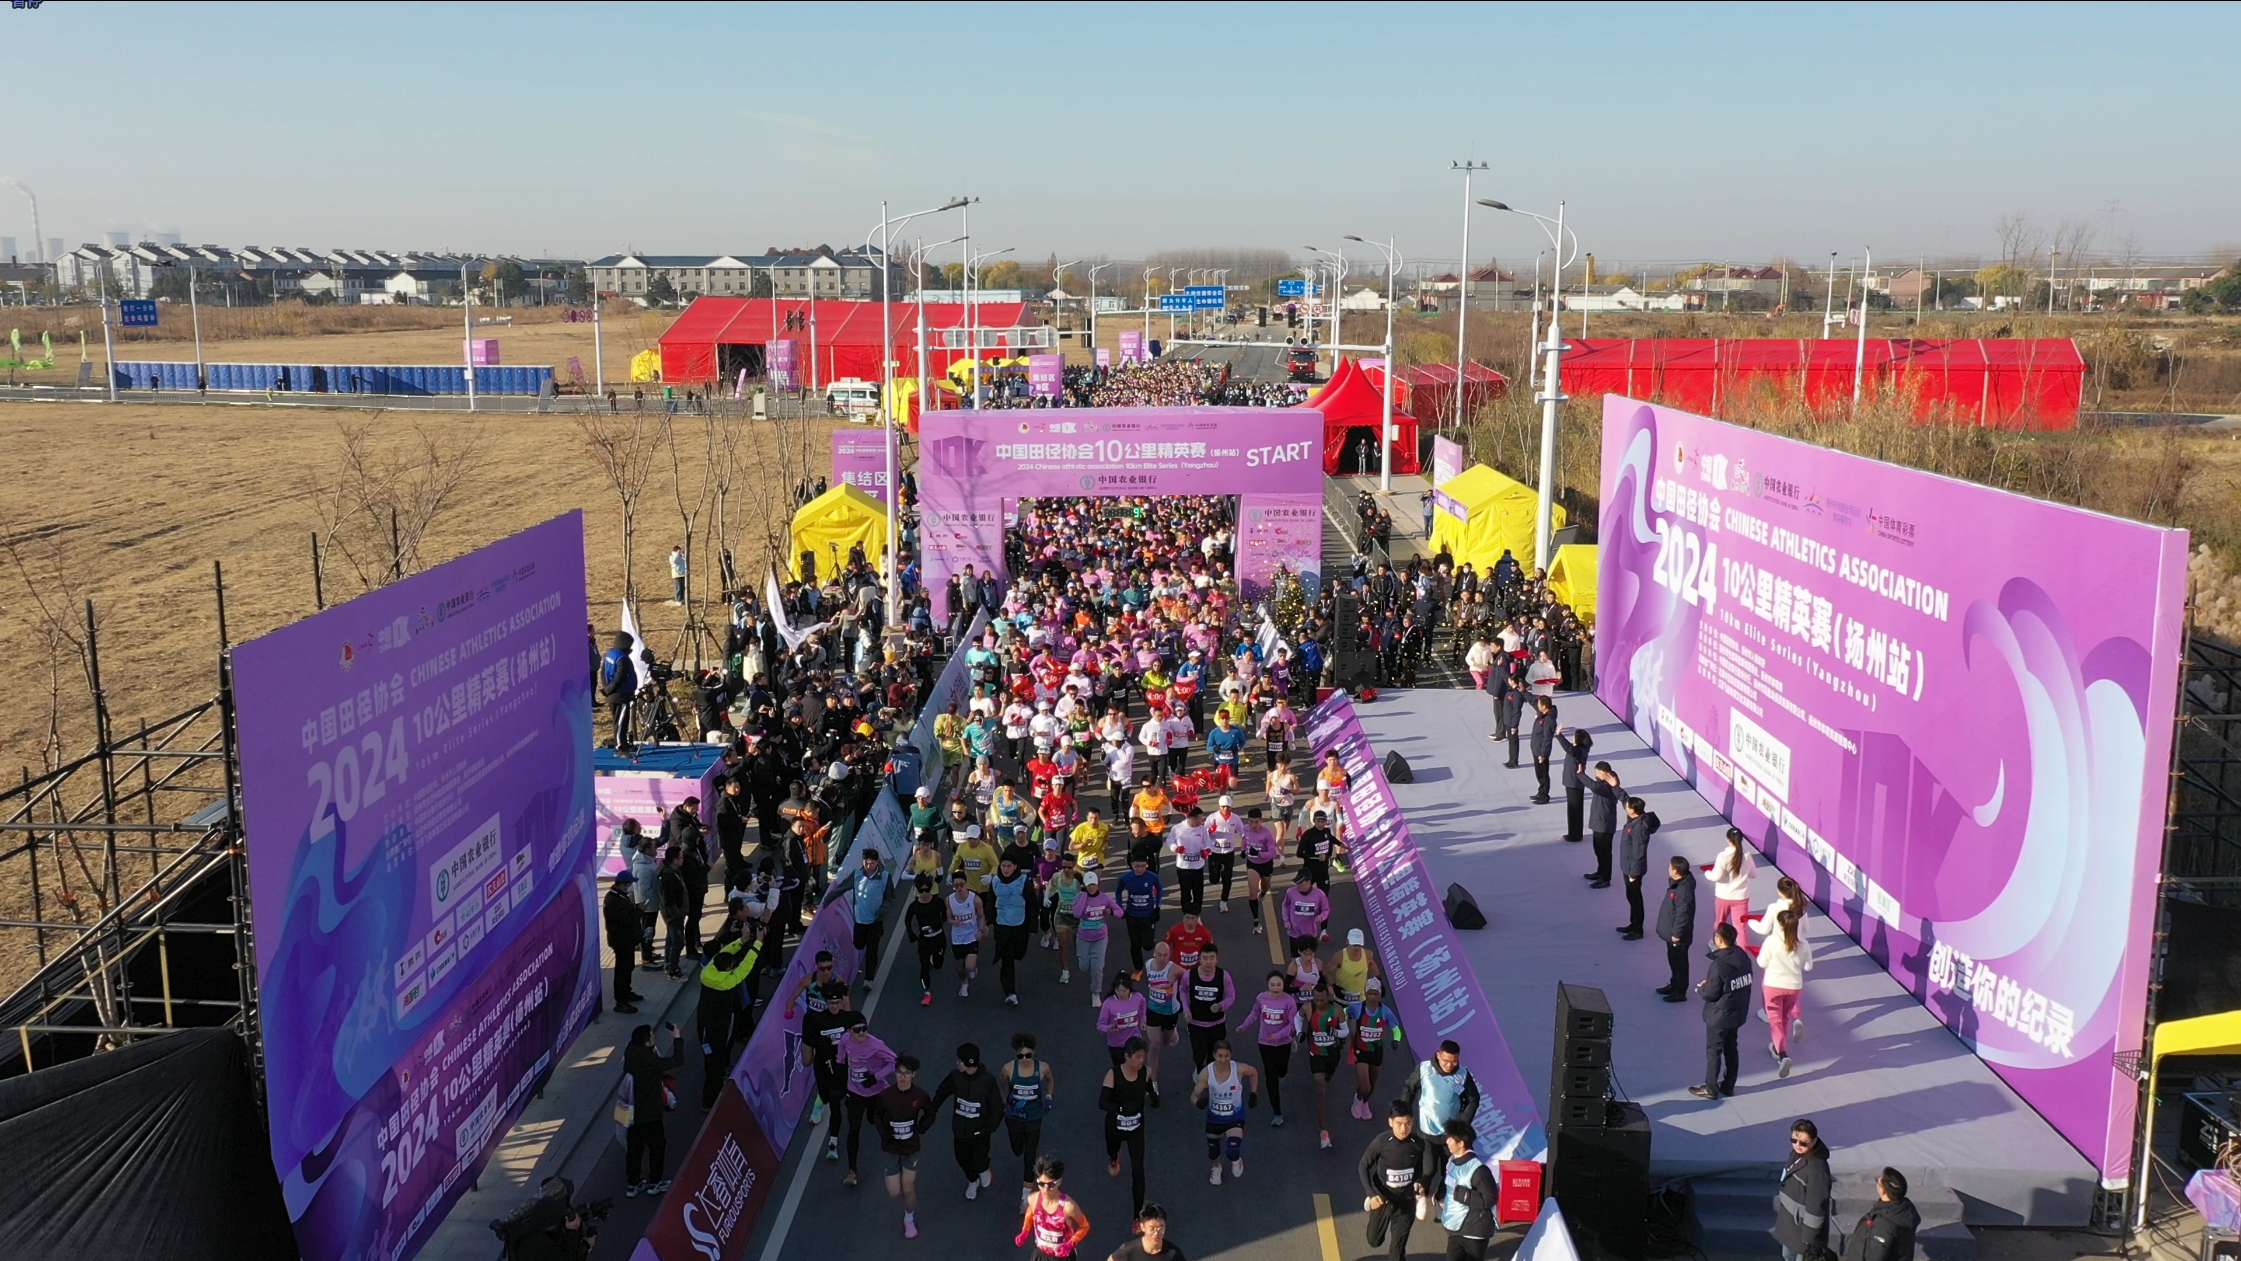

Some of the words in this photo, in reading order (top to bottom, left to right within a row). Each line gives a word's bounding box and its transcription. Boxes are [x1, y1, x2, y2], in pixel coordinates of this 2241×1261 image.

[1098, 475, 1157, 484] 中国农业银行
[1246, 441, 1313, 467] START
[1264, 509, 1316, 517] 中国农业银行
[1656, 476, 1722, 533] 中国田径协会
[1725, 508, 1769, 546] CHINESE
[1770, 526, 1836, 575] ATHLETICS
[1839, 553, 1949, 622] ASSOCIATION
[1653, 517, 1718, 616] 2024
[302, 672, 405, 755] 中国田径协会
[410, 647, 457, 689] CHINESE
[459, 620, 507, 664] ATHLETICS
[509, 590, 562, 634] ASSOCIATION
[1720, 608, 1741, 631] 10km
[1744, 623, 1766, 646] Elite
[1771, 638, 1803, 667] Series
[1806, 656, 1878, 713] (Yangzhou)
[415, 751, 439, 772] 10km
[443, 730, 466, 755] Elite
[469, 715, 494, 739] Series
[495, 682, 538, 726] (Yangzhou)
[1745, 731, 1786, 775] 中国农业银行
[307, 715, 410, 845] 2024
[451, 829, 497, 878] 中国农业银行
[1367, 895, 1380, 917] ELITE
[1730, 973, 1753, 991] CHINA
[1929, 939, 2075, 1059] 创造你的纪录
[377, 1066, 439, 1151] 中国田径协会
[442, 1030, 477, 1071] CHINESE
[478, 990, 511, 1036] ATHLETICS
[511, 942, 554, 995] ASSOCIATION
[444, 1107, 462, 1127] 10km
[465, 1086, 481, 1104] Elite
[381, 1092, 440, 1210] 2024
[718, 1168, 756, 1245] FURIOUSPORTS
